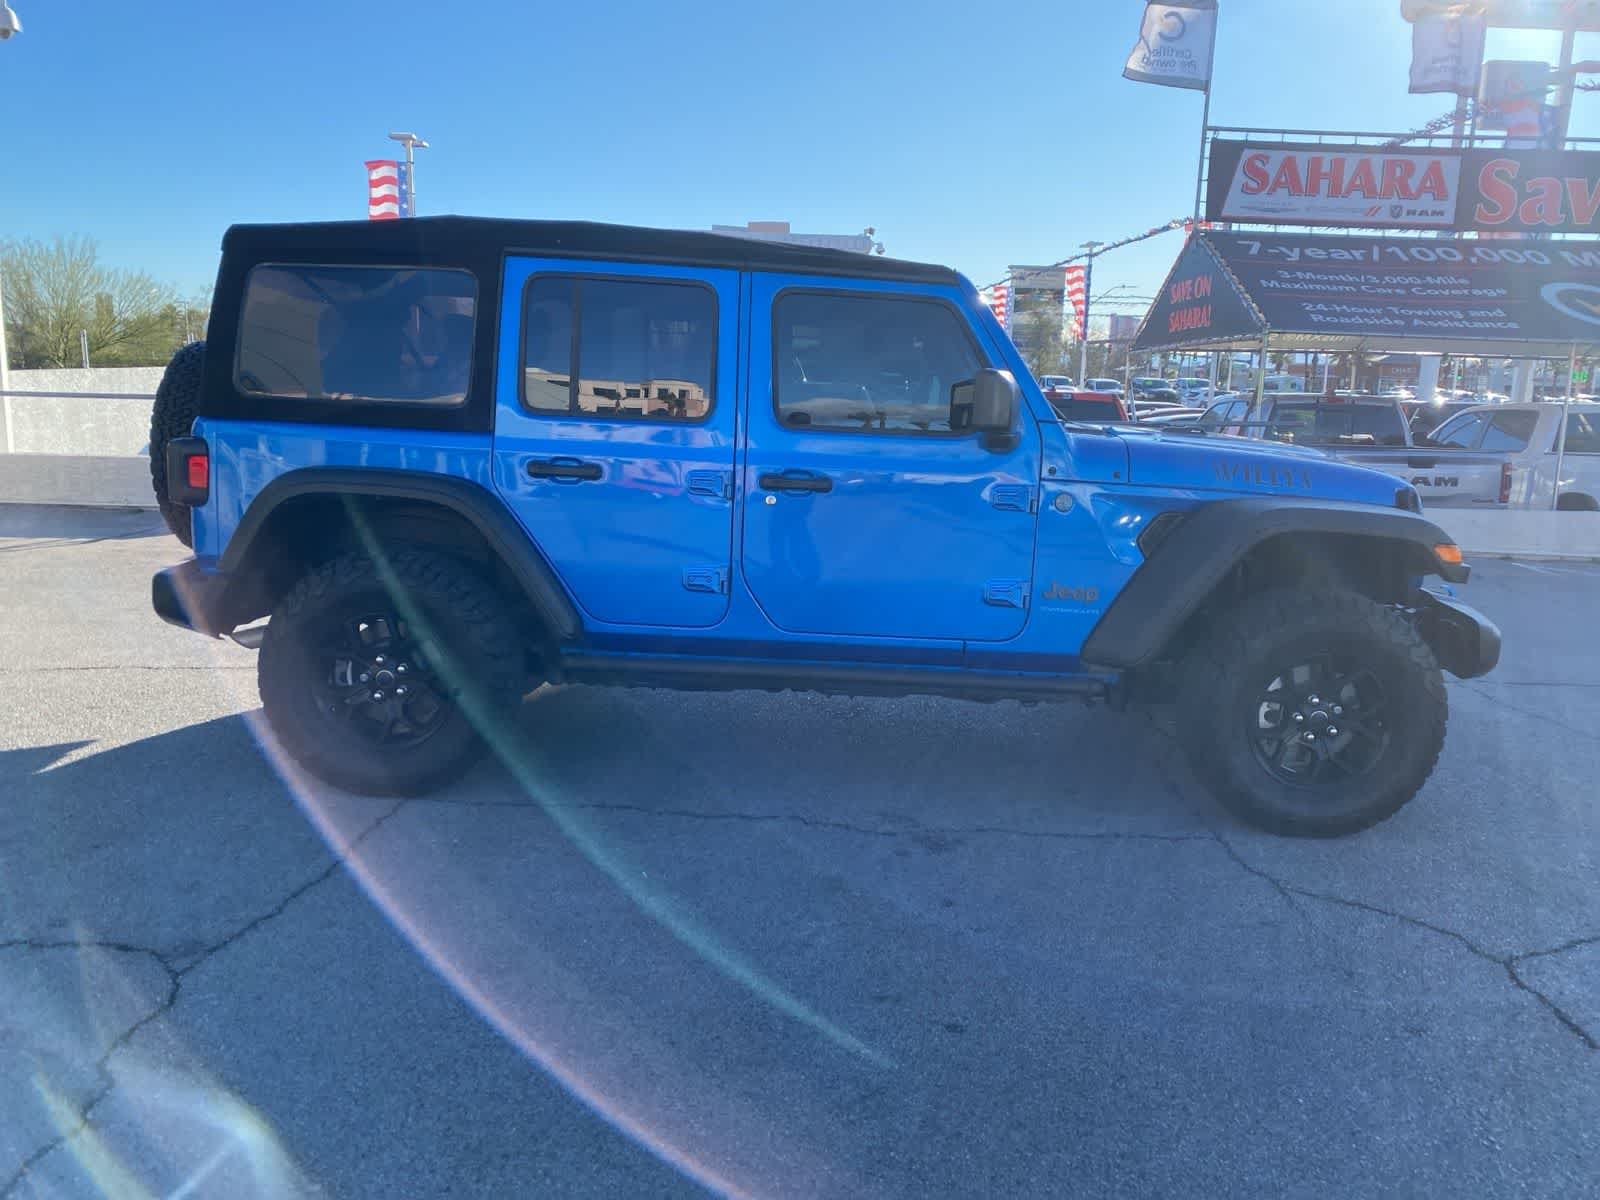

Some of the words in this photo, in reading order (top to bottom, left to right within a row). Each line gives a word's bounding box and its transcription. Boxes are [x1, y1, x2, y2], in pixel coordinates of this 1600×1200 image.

[1240, 153, 1448, 201] SAHARA
[1170, 279, 1193, 304] SAVE
[1194, 273, 1213, 298] ON
[1260, 279, 1357, 293] Maximum
[1362, 285, 1406, 295] Care
[1411, 286, 1508, 297] Coverage
[1302, 302, 1383, 315] 24-Hour
[1386, 306, 1465, 319] Towing
[1469, 307, 1507, 317] and
[1310, 313, 1405, 326] Roadside
[1413, 318, 1521, 329] Assistance
[1400, 475, 1459, 488] AM
[1042, 580, 1099, 606] Jeep
